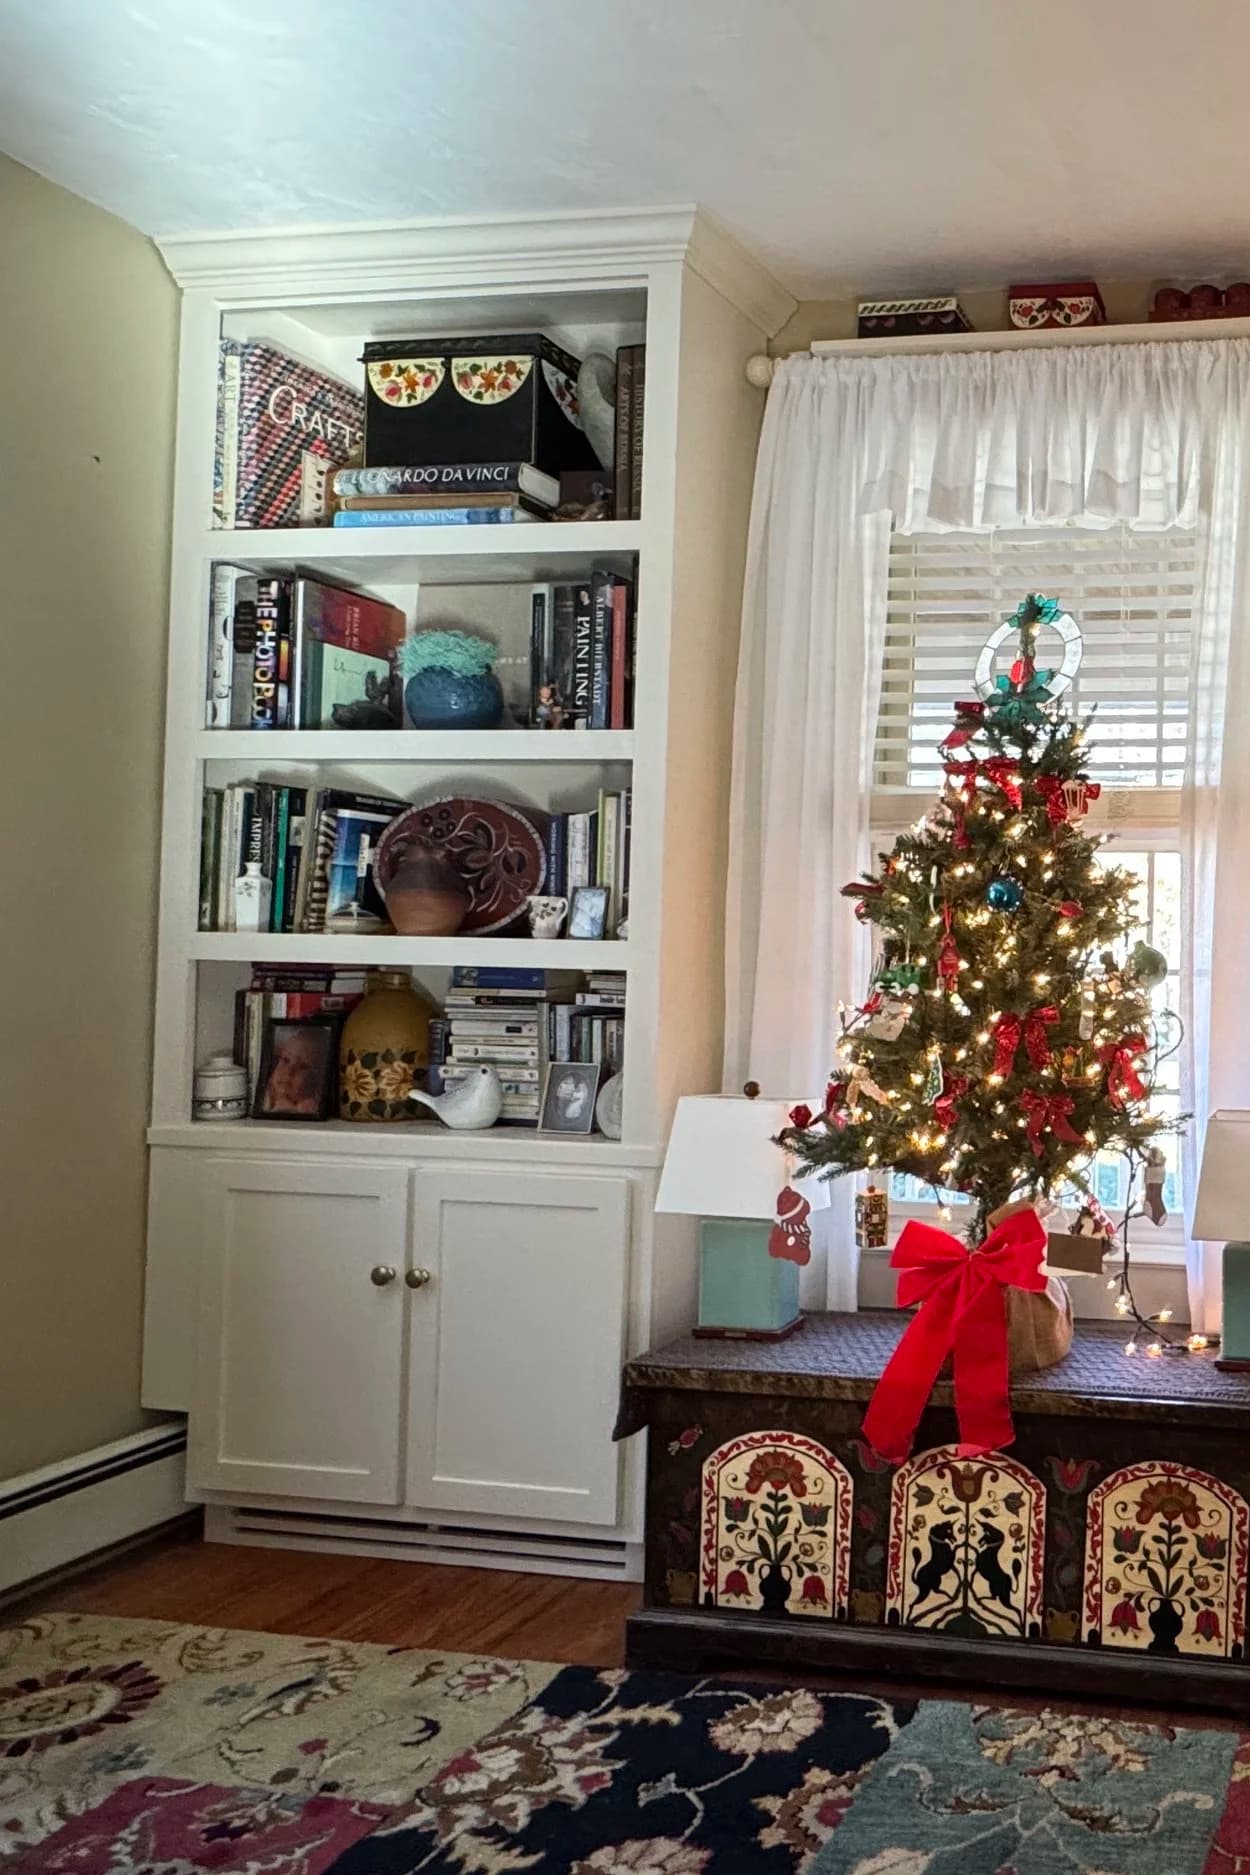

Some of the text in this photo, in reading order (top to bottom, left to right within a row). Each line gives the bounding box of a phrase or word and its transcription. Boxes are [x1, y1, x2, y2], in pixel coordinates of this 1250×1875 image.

[351, 467, 439, 484] LEONARDO
[464, 466, 509, 482] VINCI
[256, 580, 278, 618] THE
[594, 595, 605, 640] ALBERT
[574, 615, 591, 706] PAINTING
